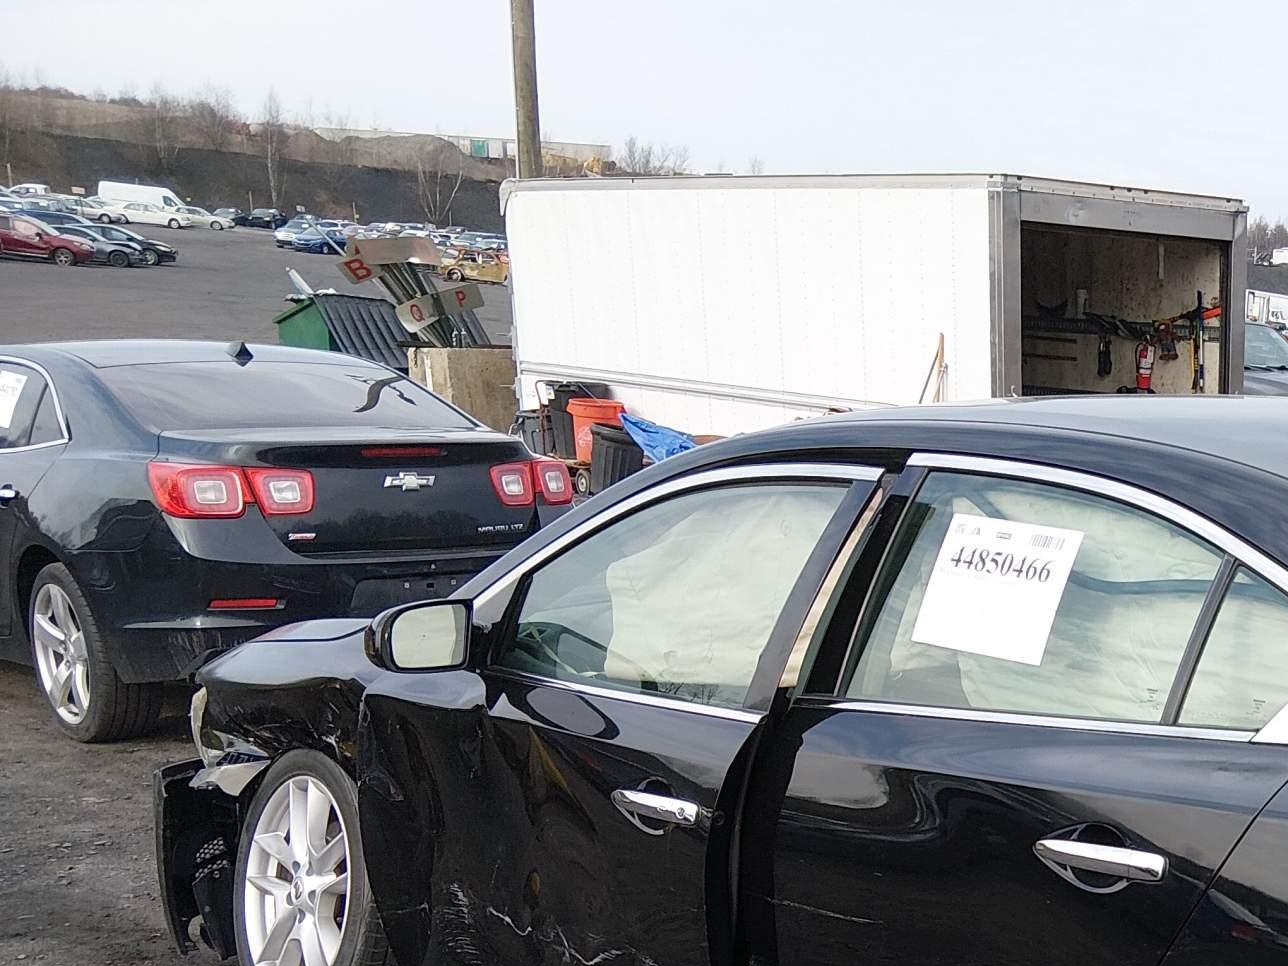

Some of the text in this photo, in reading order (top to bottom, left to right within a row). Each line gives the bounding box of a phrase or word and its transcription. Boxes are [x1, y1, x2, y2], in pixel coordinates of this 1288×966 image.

[343, 258, 373, 282] B
[455, 290, 466, 306] P
[409, 303, 425, 323] Q
[950, 545, 1055, 583] 44850466
